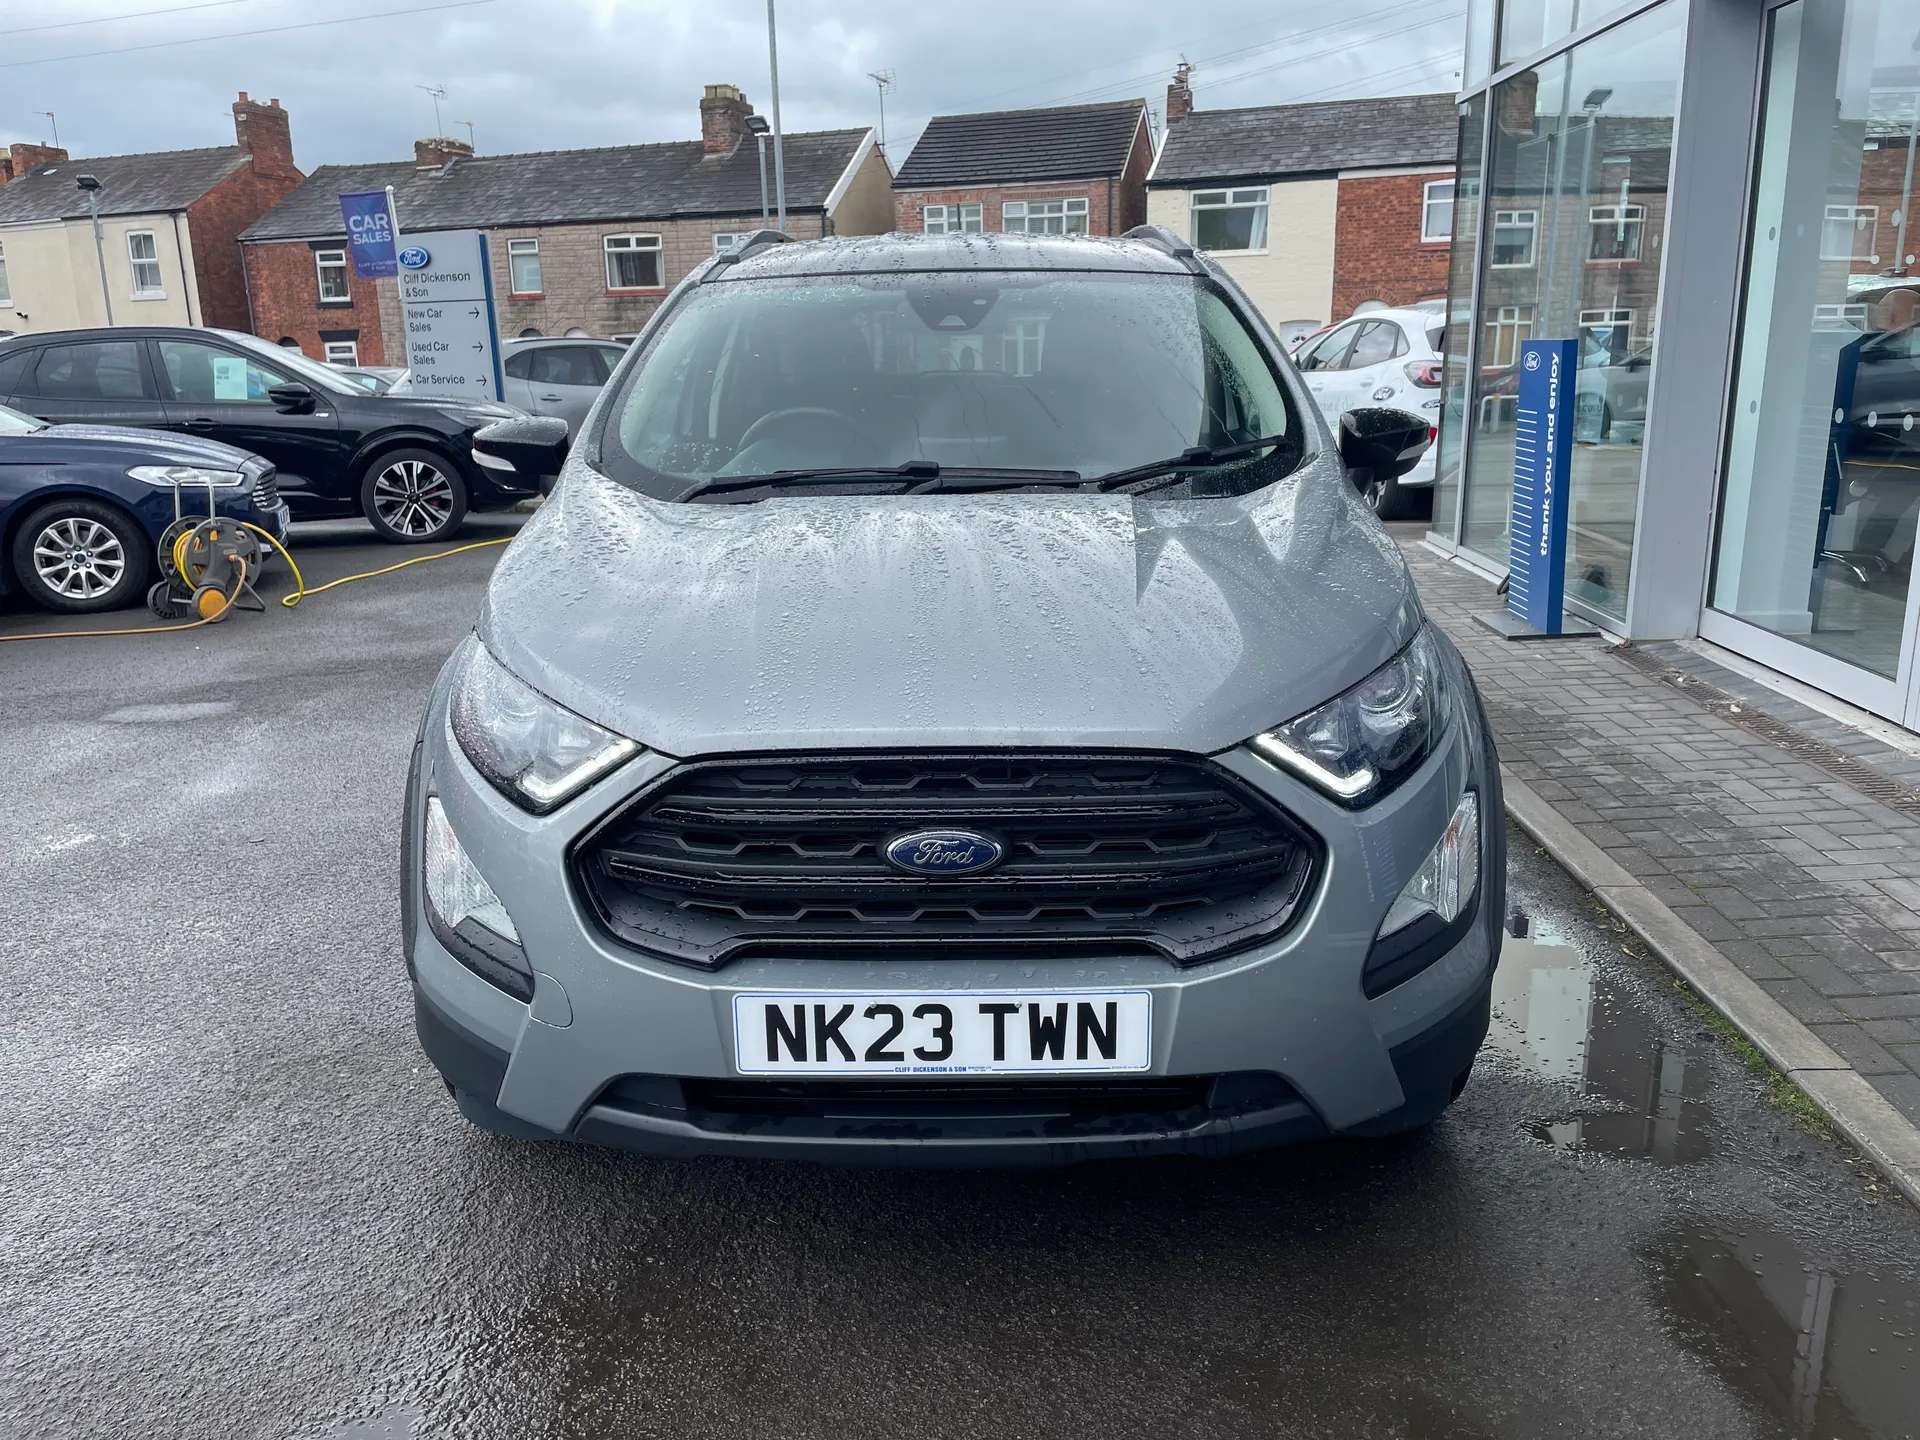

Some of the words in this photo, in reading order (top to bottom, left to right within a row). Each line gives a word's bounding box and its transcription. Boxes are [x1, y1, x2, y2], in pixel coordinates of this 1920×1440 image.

[349, 213, 390, 232] CAR
[353, 230, 392, 245] SALES
[401, 249, 426, 266] Ford
[403, 273, 420, 285] Cliff
[420, 272, 471, 284] Dickenson
[407, 309, 426, 319] New
[427, 308, 443, 318] Car
[409, 322, 432, 333] Sales
[411, 342, 432, 352] Used
[433, 341, 450, 352] Car
[413, 355, 436, 365] Sales
[416, 375, 430, 385] Car
[431, 374, 466, 385] Service
[1549, 352, 1560, 410] enjoy
[1547, 413, 1555, 454] and
[1544, 457, 1553, 495] you
[1540, 498, 1550, 556] thank
[913, 839, 975, 865] Ford
[764, 1003, 954, 1062] NK23
[978, 1001, 1118, 1061] TWN
